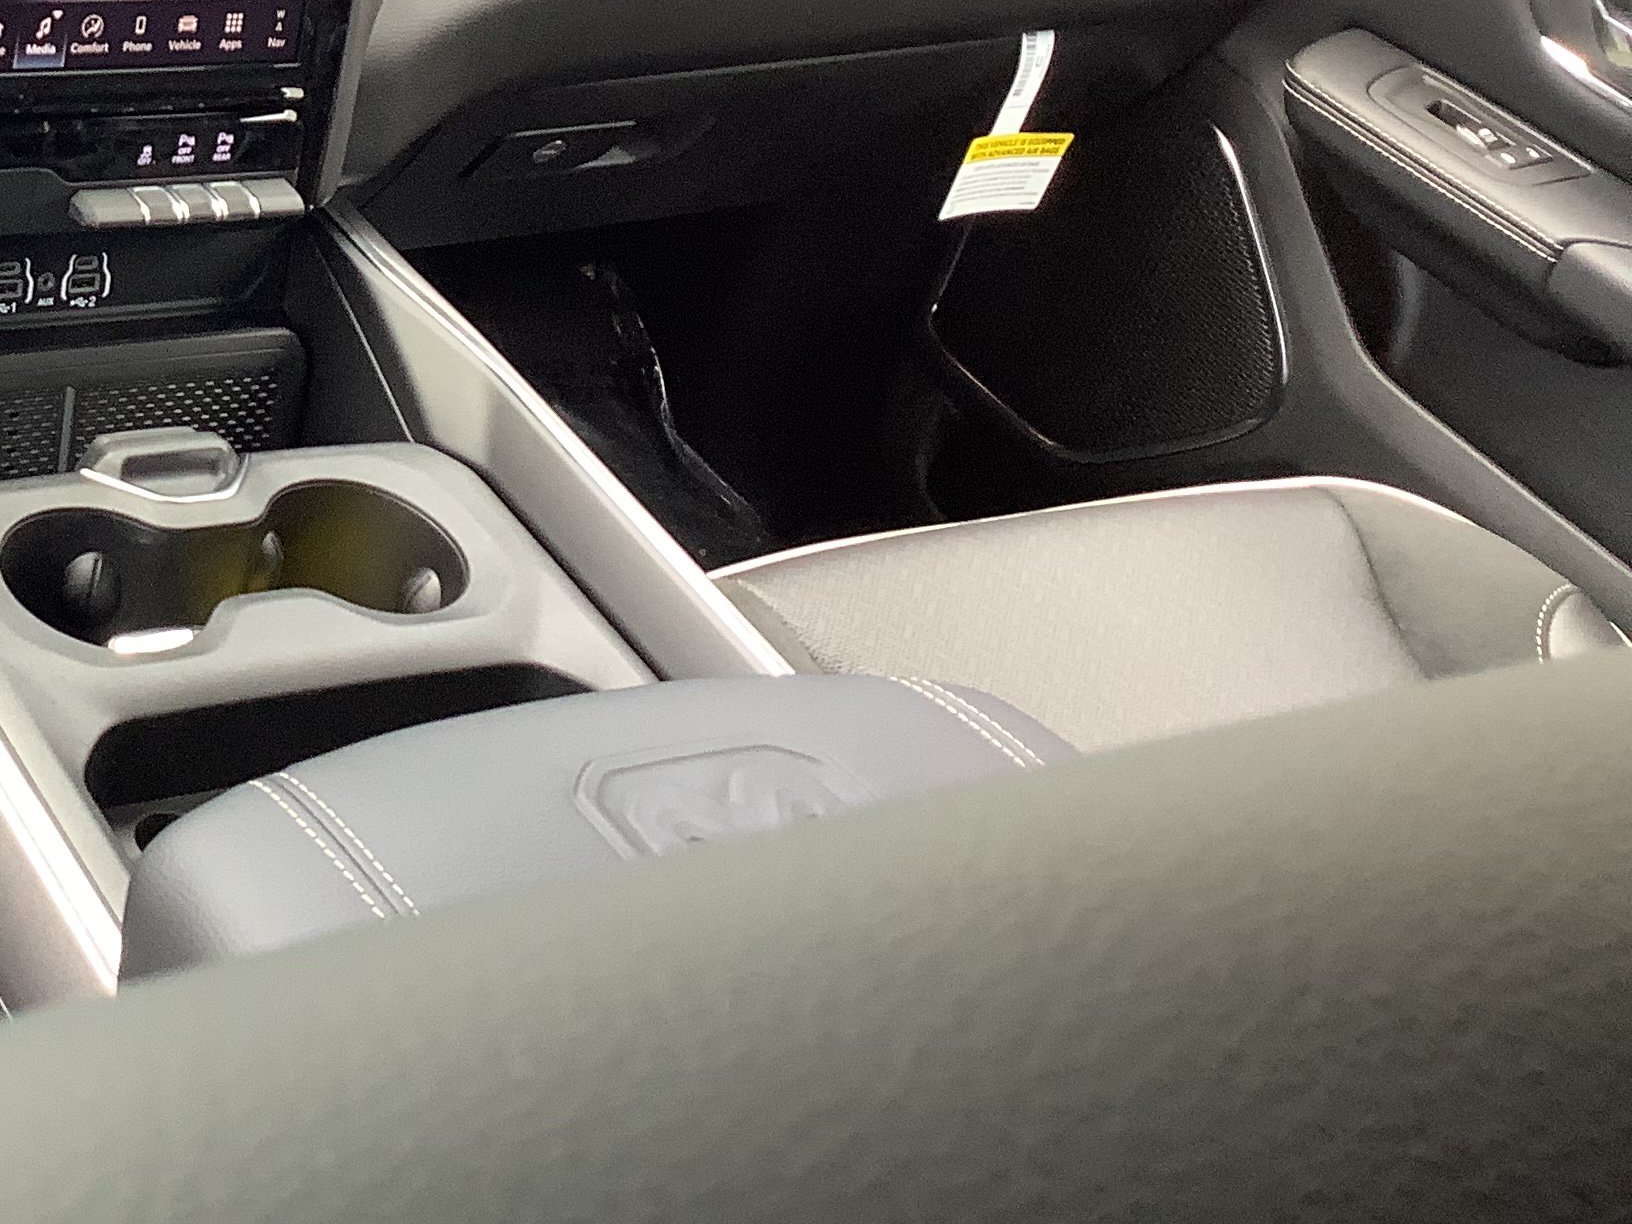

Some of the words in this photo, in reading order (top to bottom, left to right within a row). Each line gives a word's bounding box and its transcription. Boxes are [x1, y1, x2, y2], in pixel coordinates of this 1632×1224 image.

[70, 41, 110, 55] Comfort
[122, 40, 153, 52] Phone
[168, 38, 202, 51] Vehicle
[218, 38, 243, 52] Apps
[267, 37, 287, 48] Nav
[25, 43, 57, 55] Media
[10, 301, 18, 313] 1
[36, 296, 55, 307] AUX
[87, 295, 97, 308] 2
